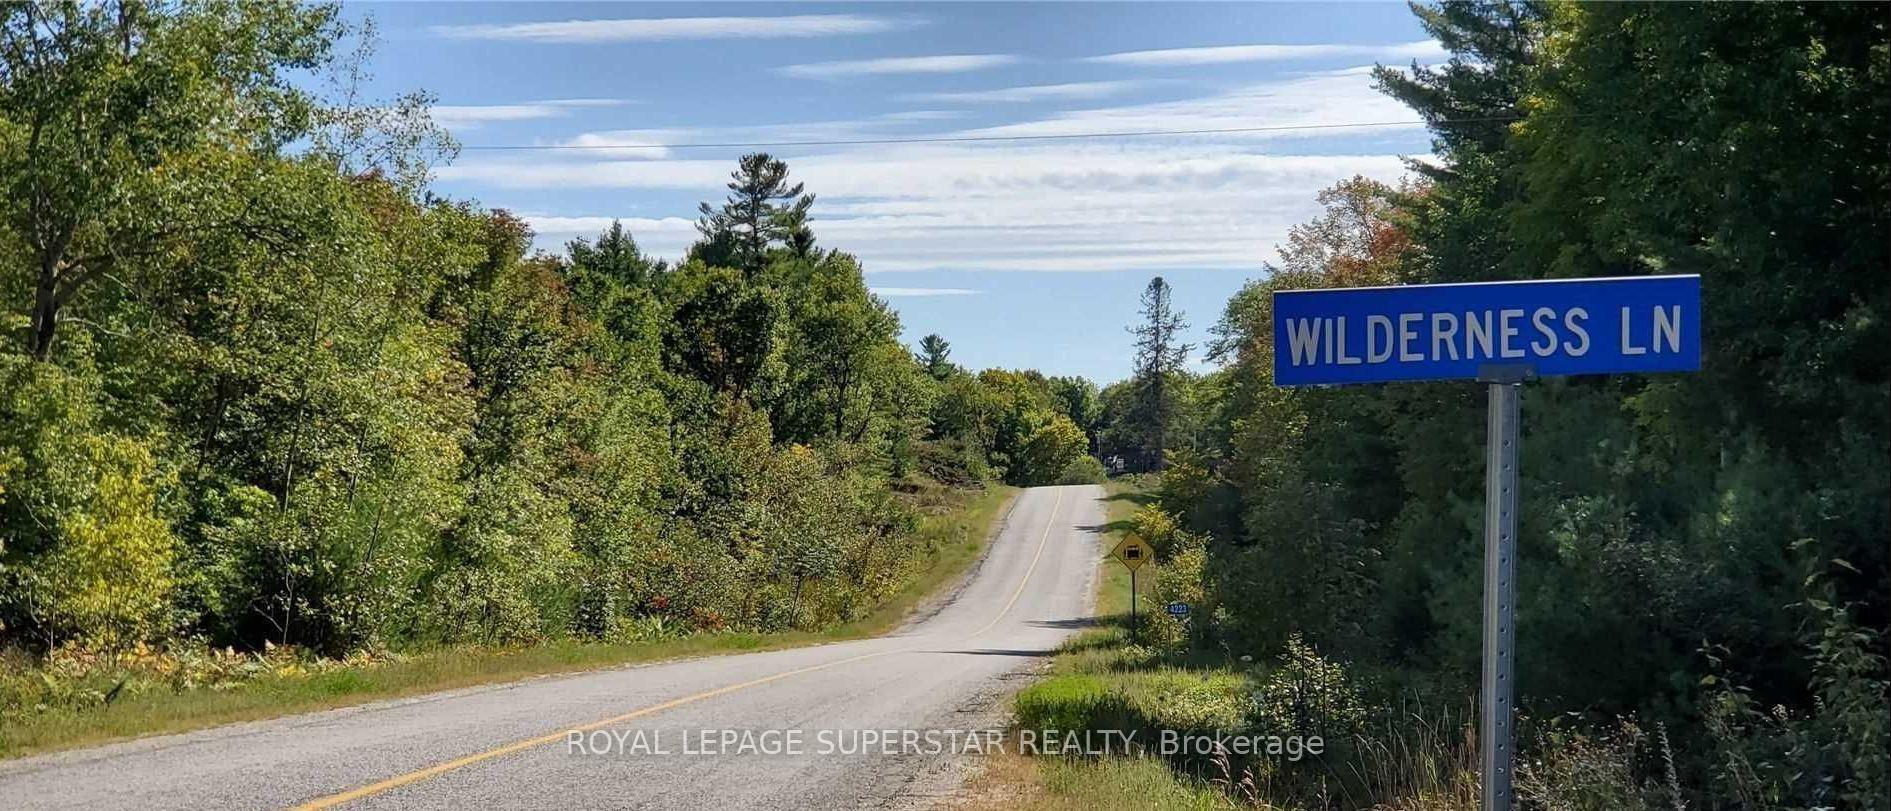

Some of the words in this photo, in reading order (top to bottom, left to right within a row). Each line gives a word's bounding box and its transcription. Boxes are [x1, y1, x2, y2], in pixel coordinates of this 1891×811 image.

[1286, 307, 1590, 366] WILDERNESS
[1621, 305, 1681, 355] LN
[1170, 604, 1187, 613] 4223
